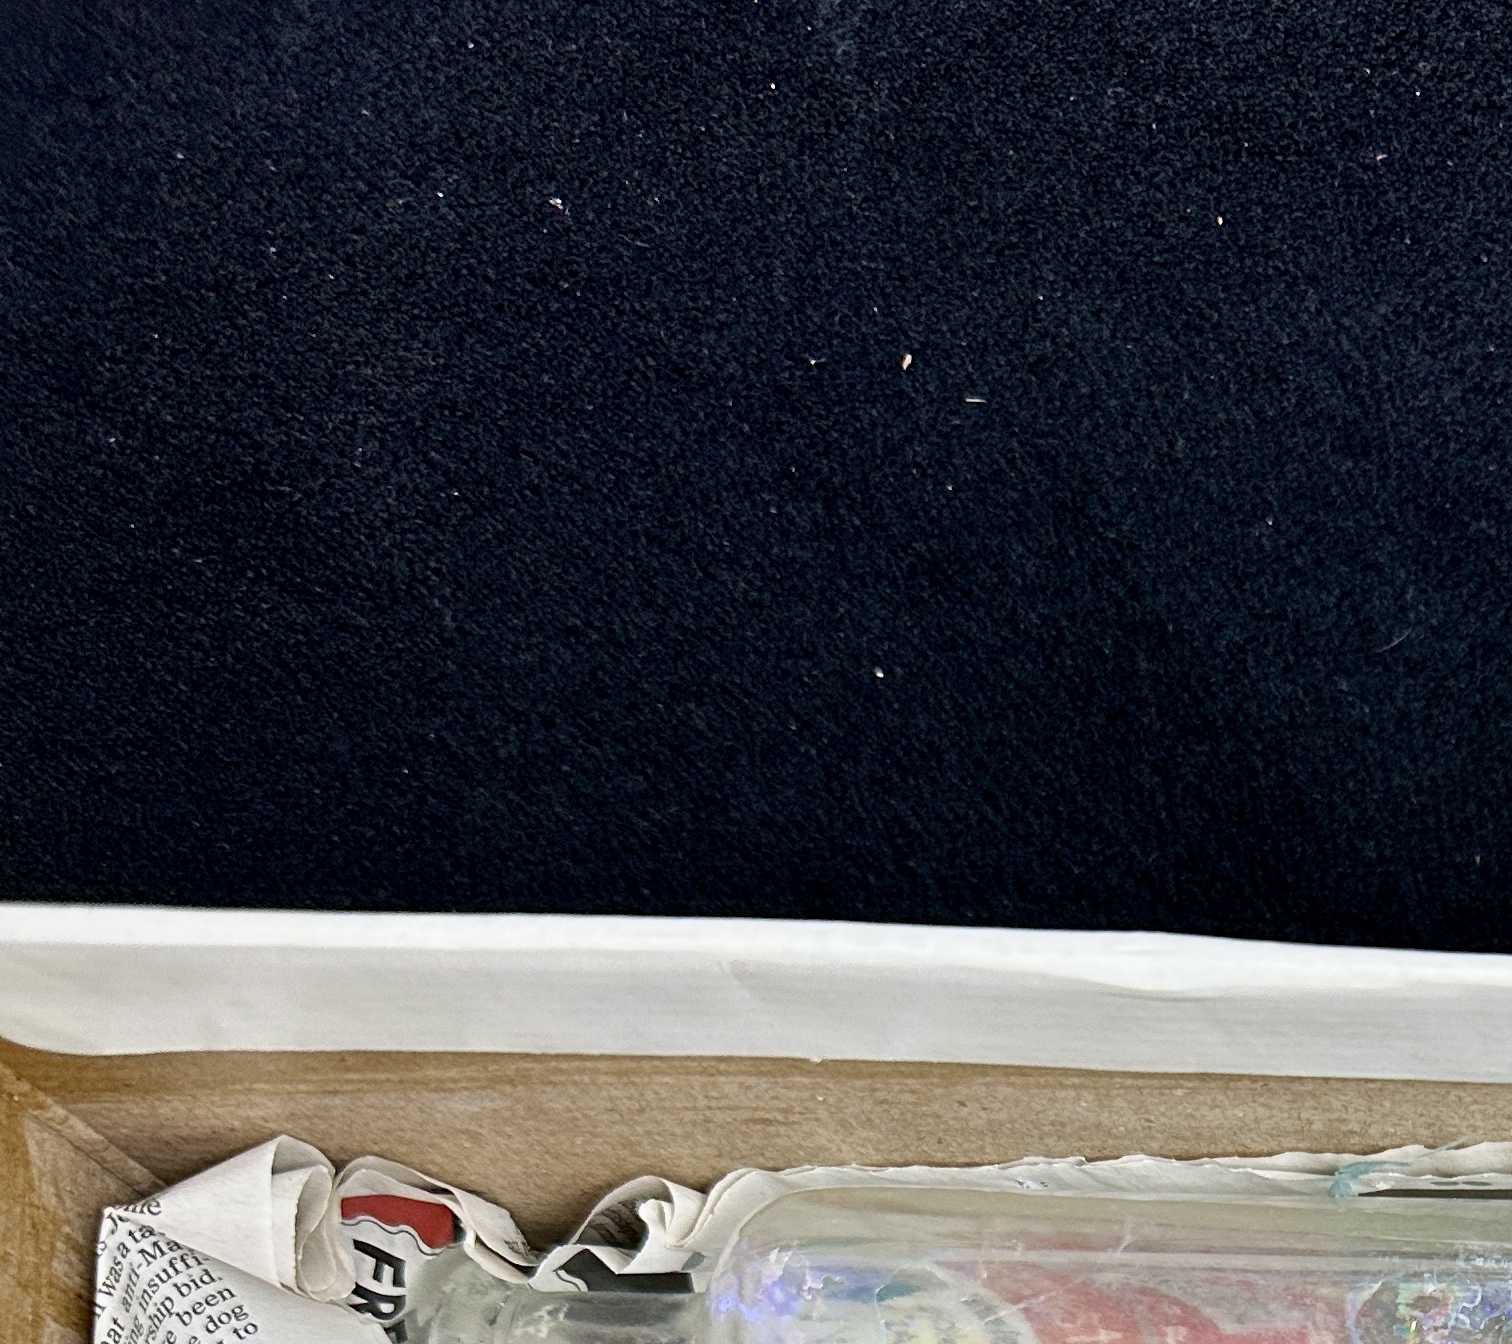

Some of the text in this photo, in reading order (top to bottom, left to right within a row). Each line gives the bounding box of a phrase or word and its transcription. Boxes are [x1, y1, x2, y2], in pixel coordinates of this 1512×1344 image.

[98, 1256, 124, 1298] was
[117, 1241, 129, 1259] a
[121, 1239, 185, 1313] anti-Ma
[173, 1268, 224, 1298] bid.
[175, 1286, 238, 1327] been
[205, 1303, 251, 1336] dog
[232, 1321, 259, 1342] to
